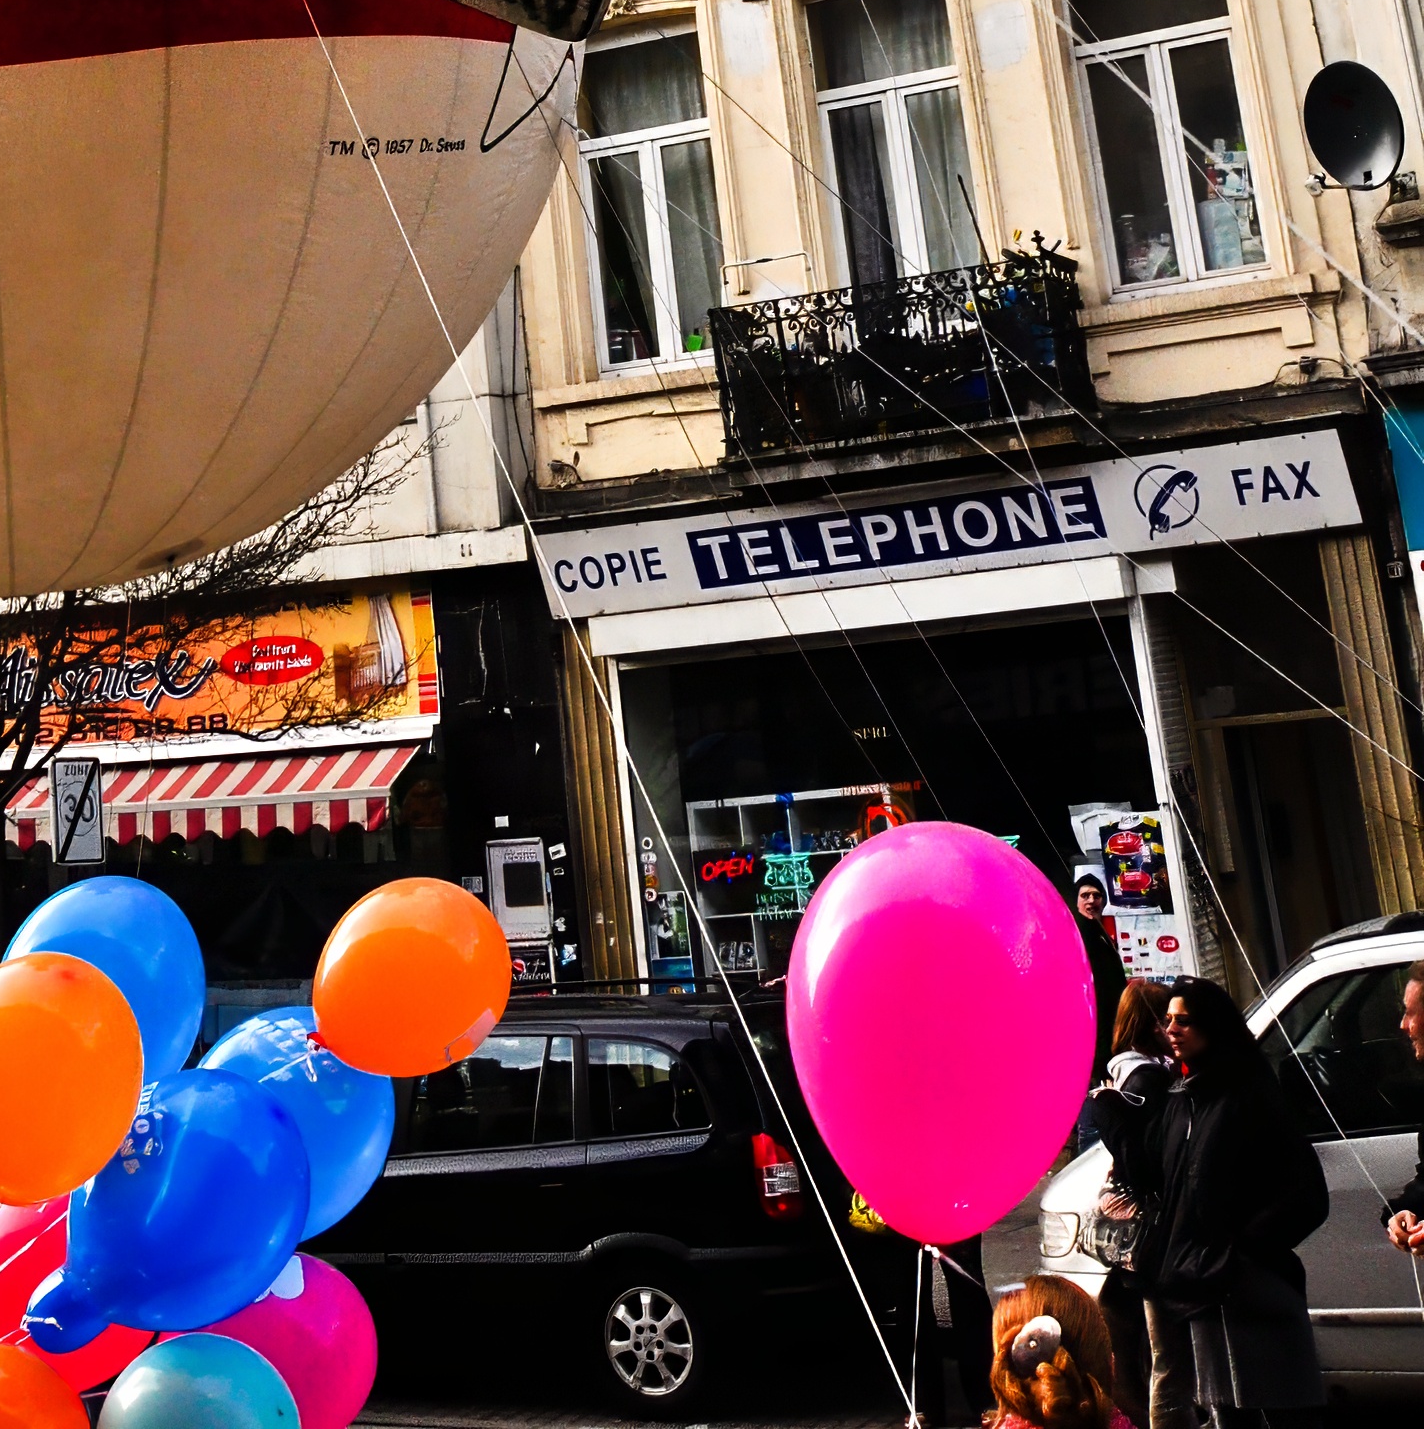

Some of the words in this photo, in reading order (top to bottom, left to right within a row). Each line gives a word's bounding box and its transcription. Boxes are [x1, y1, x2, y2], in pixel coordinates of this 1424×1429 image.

[329, 140, 356, 156] TM
[435, 137, 466, 153] Seuss
[554, 546, 668, 593] COPIE
[696, 485, 1094, 581] TELEPHONE
[1231, 460, 1321, 506] FAX
[64, 793, 95, 823] 30
[701, 857, 754, 881] OPEN
